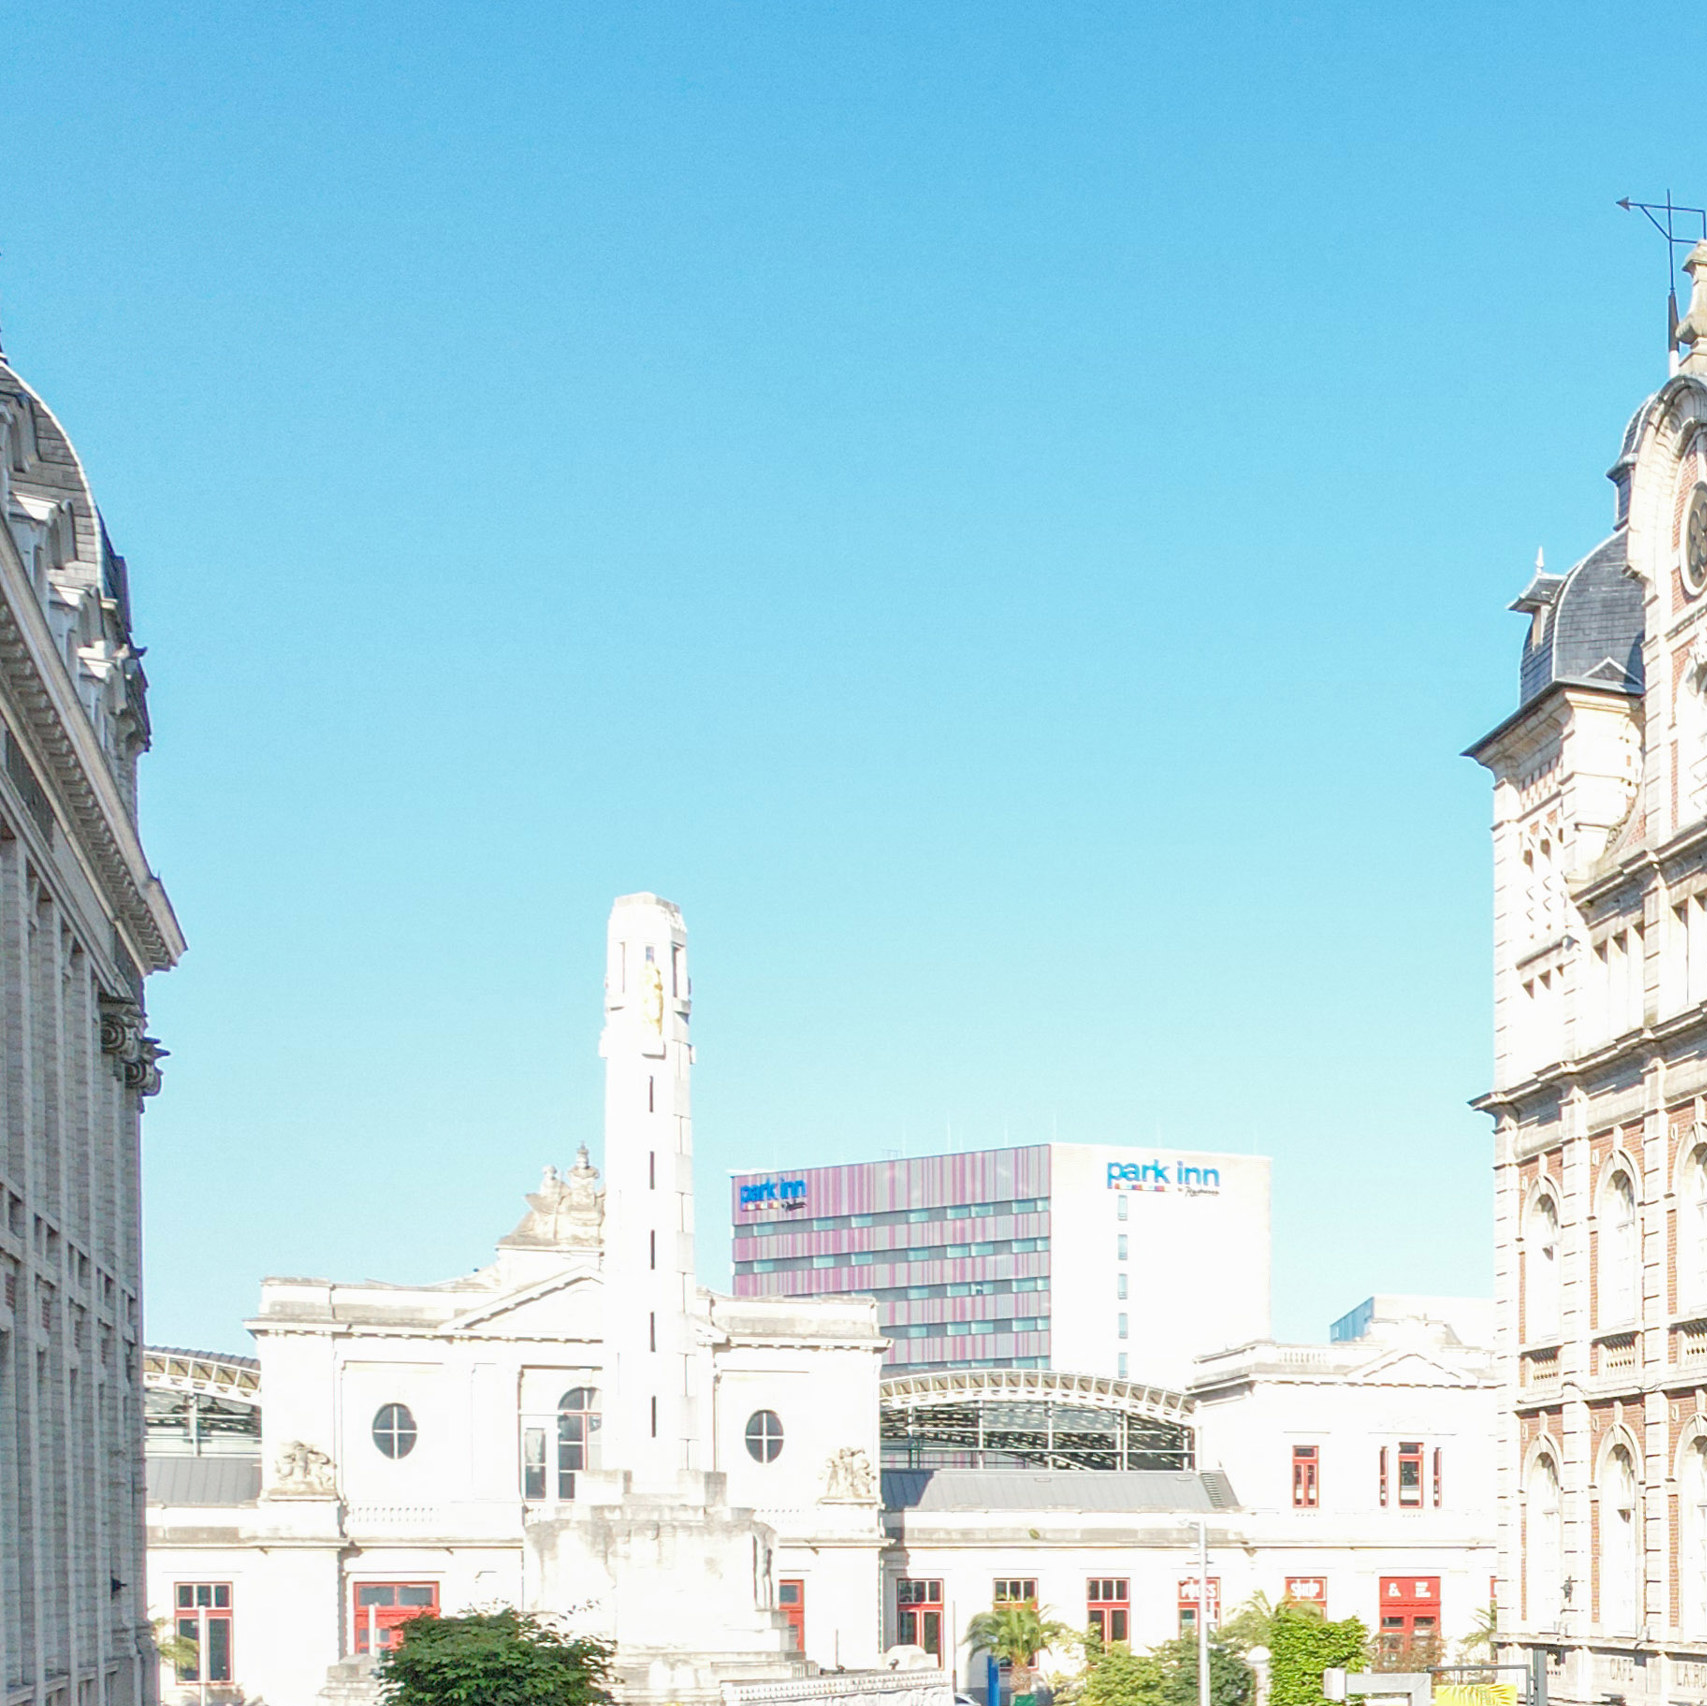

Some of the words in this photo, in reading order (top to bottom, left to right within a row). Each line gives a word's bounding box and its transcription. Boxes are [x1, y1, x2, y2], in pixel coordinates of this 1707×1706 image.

[1107, 1159, 1171, 1189] park
[1177, 1161, 1219, 1187] inn
[740, 1178, 778, 1204] park
[780, 1177, 806, 1199] inn
